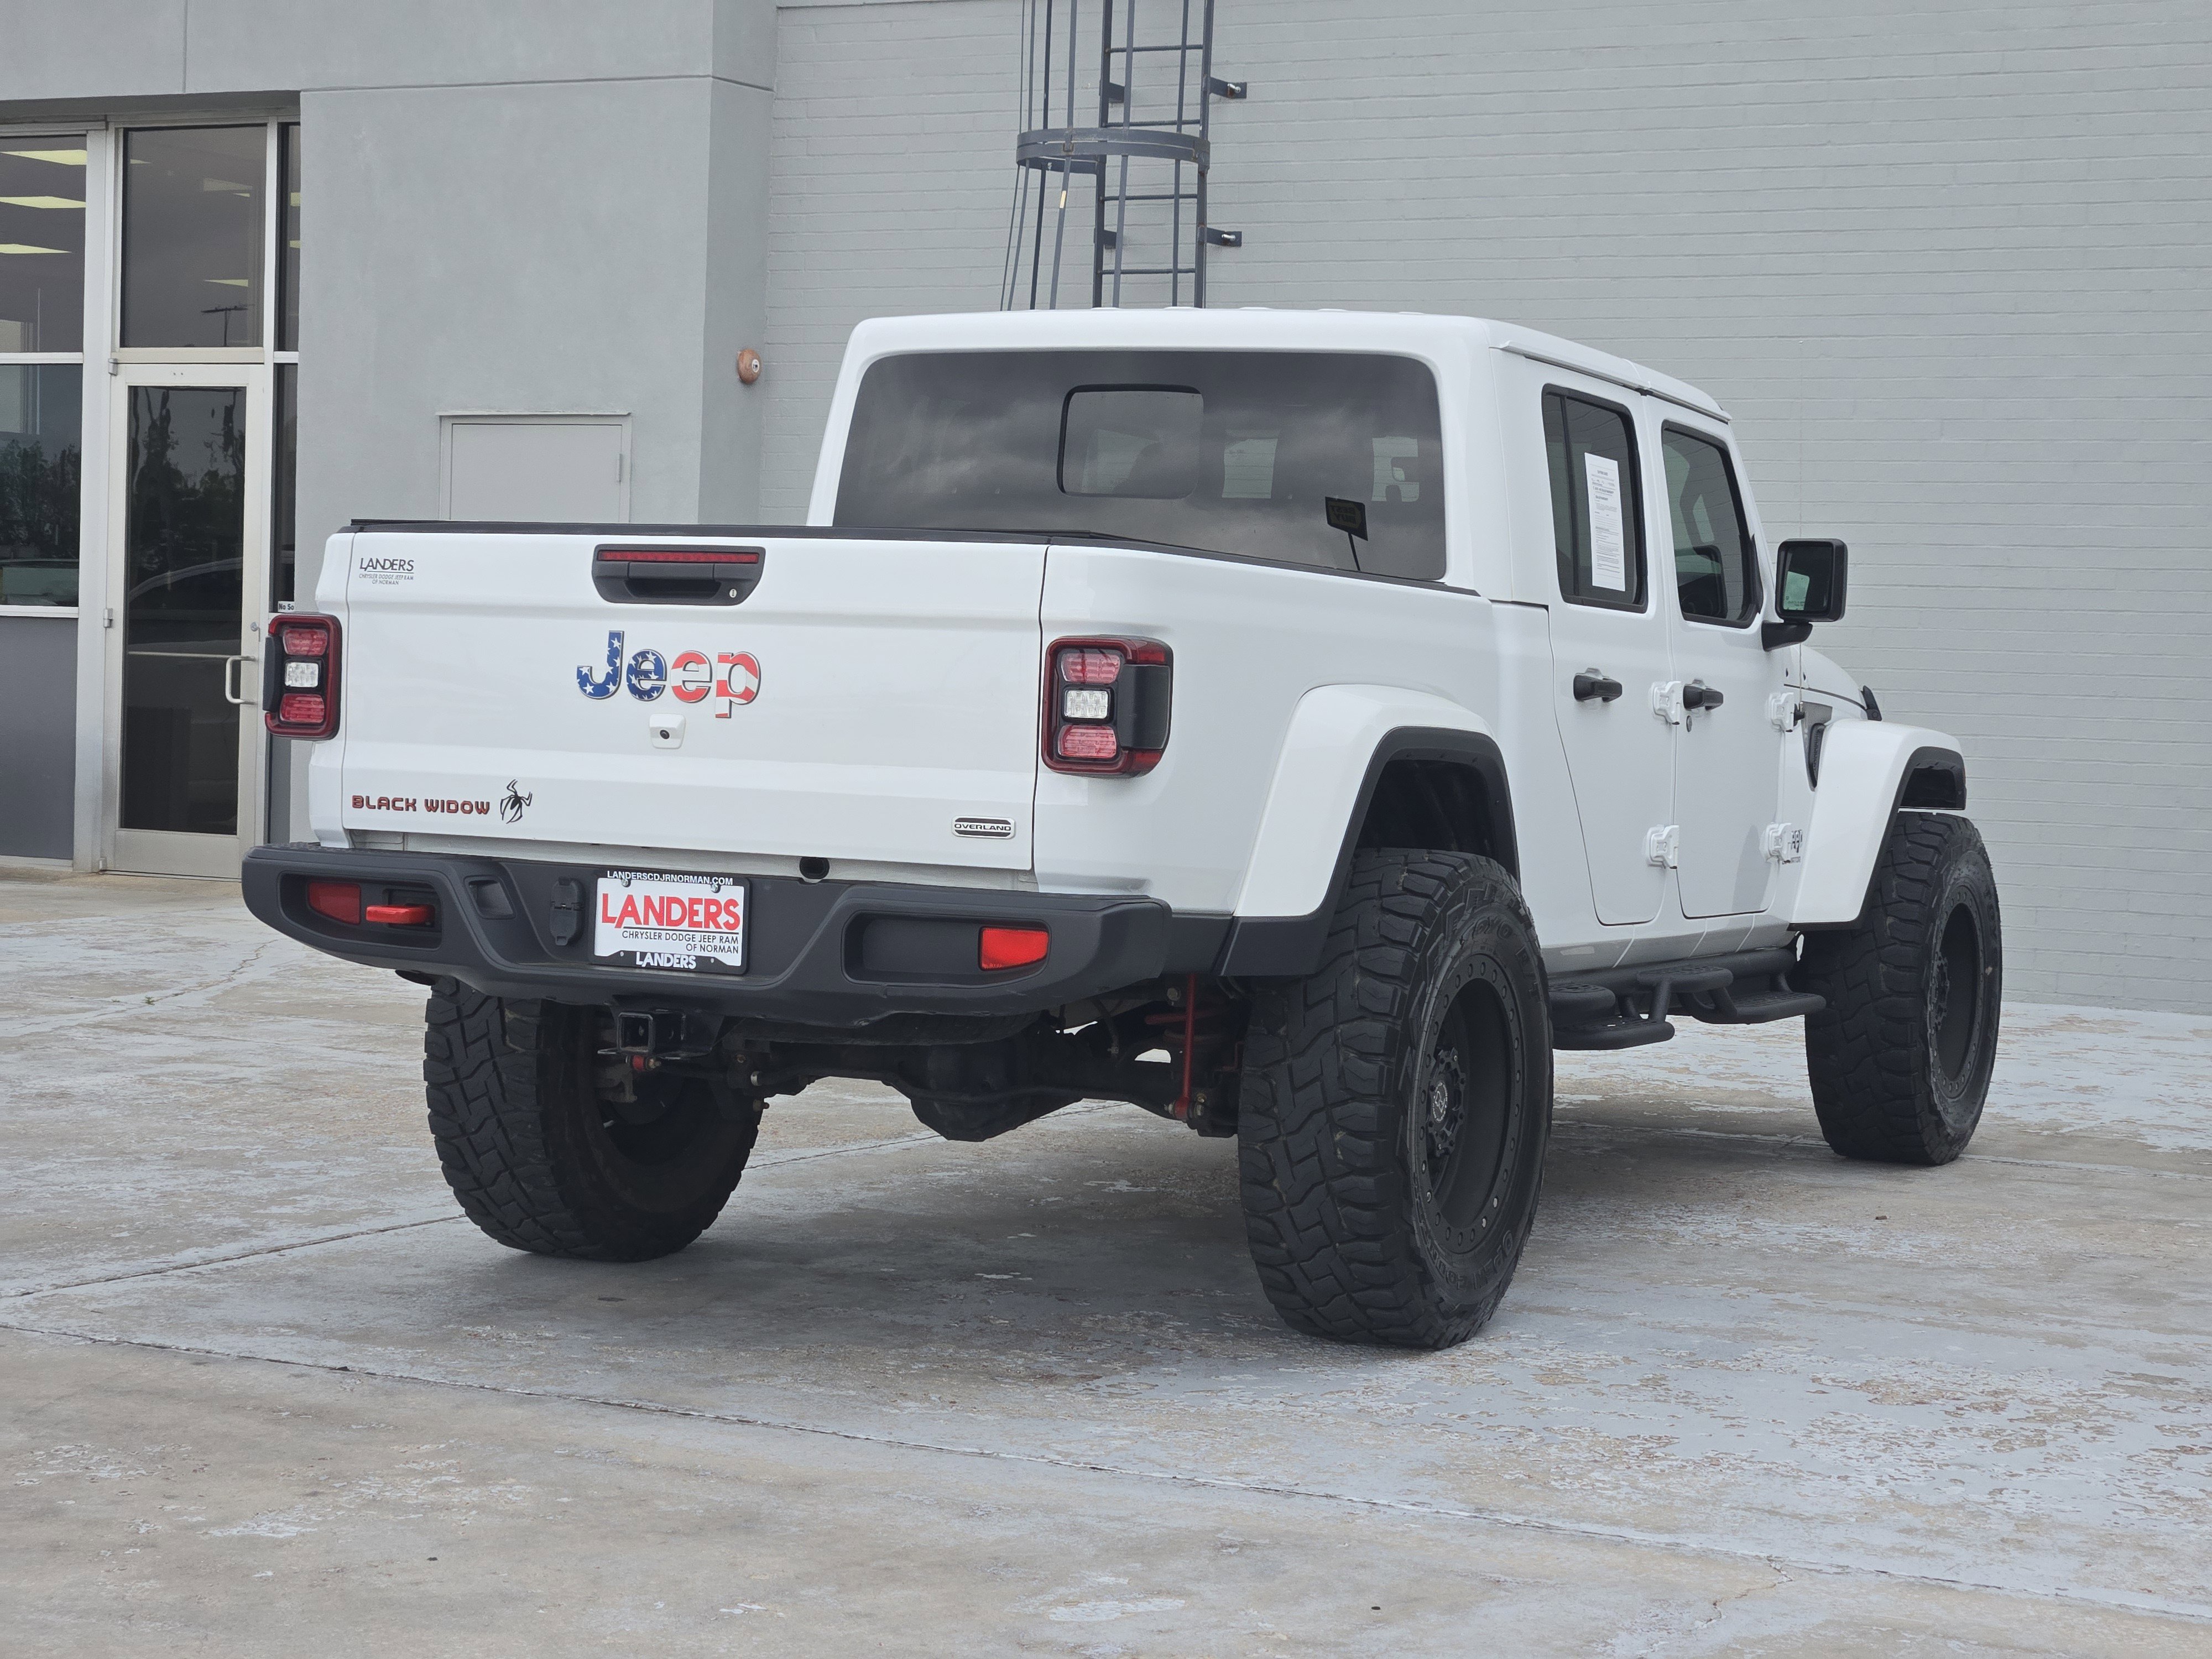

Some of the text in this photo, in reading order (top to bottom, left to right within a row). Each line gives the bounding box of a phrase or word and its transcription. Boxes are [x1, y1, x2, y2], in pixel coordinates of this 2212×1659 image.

[359, 557, 414, 571] LANDERS
[576, 630, 761, 719] Jeep
[352, 795, 490, 815] BLACK WIDOW
[607, 870, 733, 886] LANDERSCDJRNORMAN.COM
[602, 893, 740, 931] LANDERS
[622, 930, 738, 945] CHRYSLER DODGE JEEP RAM
[686, 943, 739, 954] OF NORMAN
[636, 952, 697, 969] LANDERS
